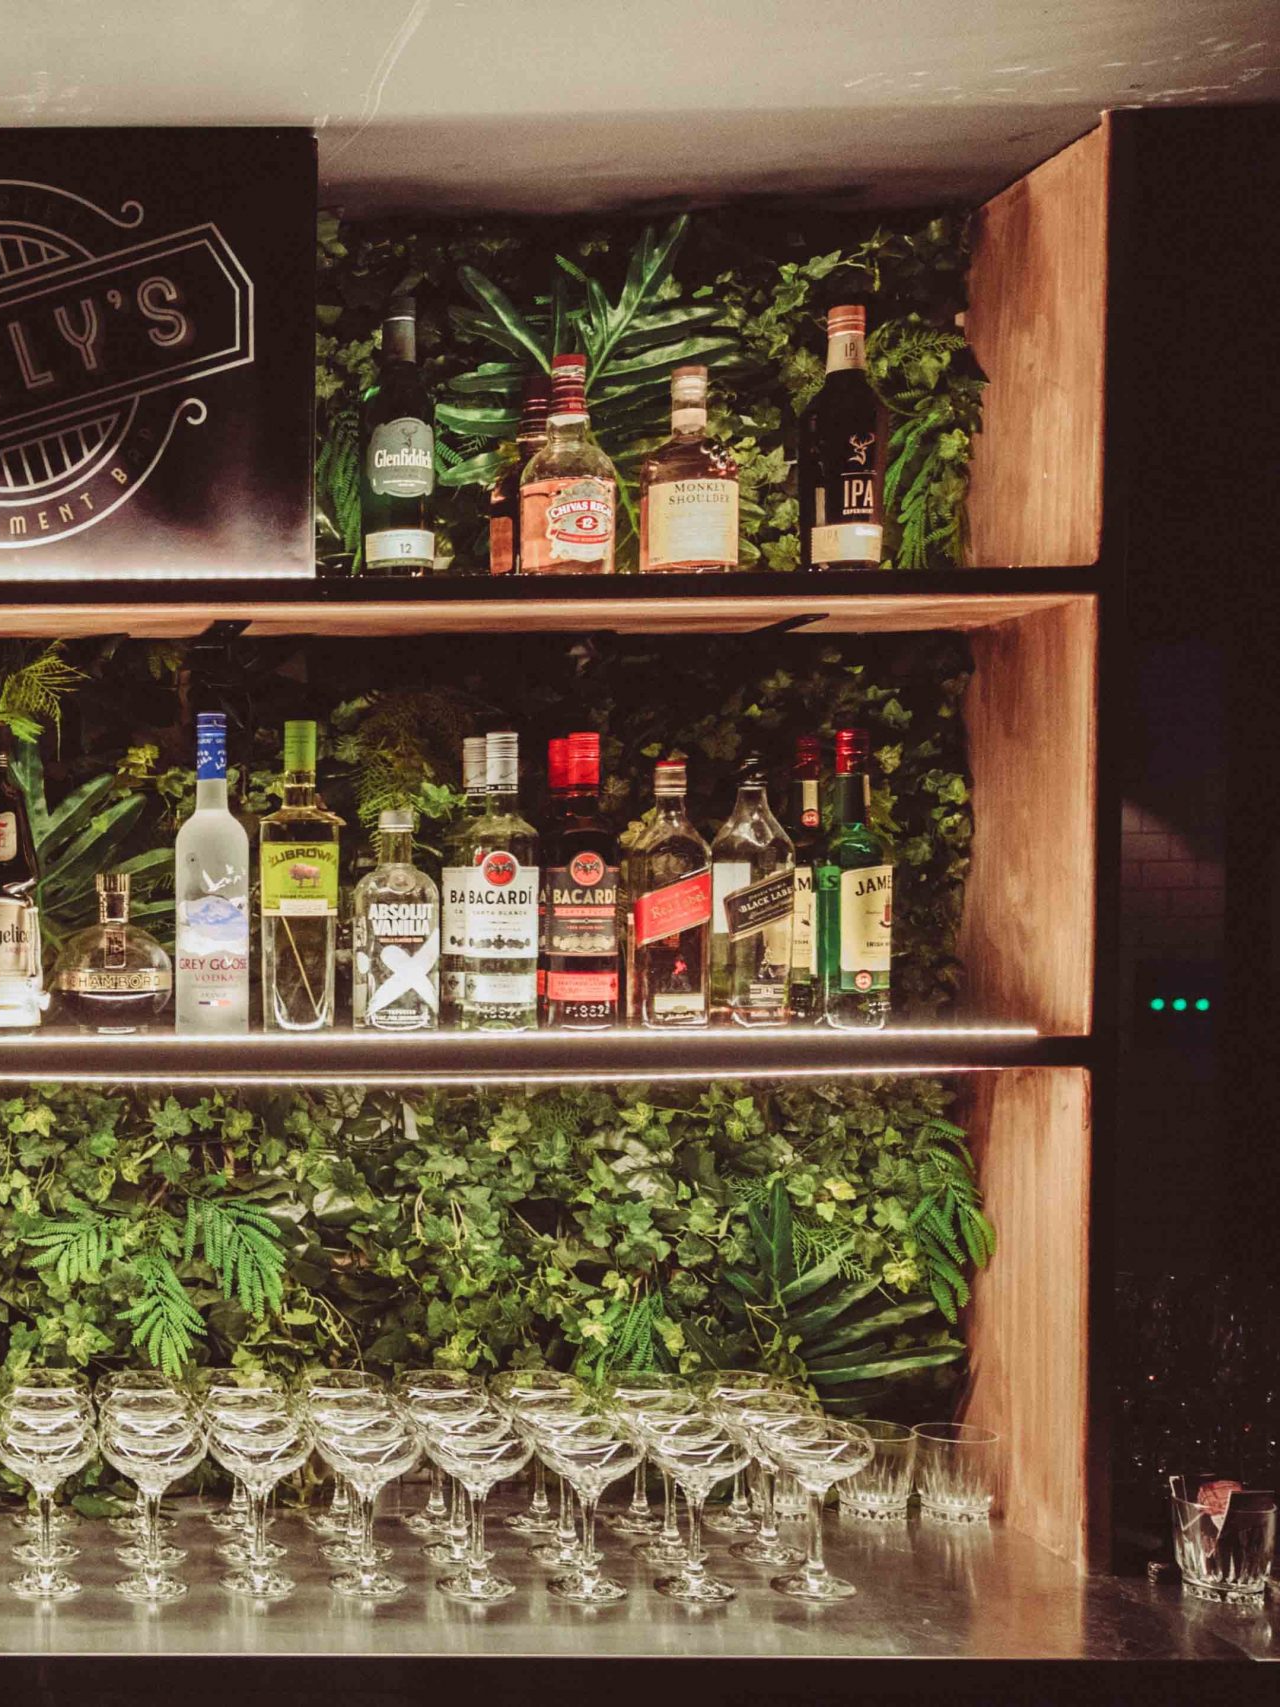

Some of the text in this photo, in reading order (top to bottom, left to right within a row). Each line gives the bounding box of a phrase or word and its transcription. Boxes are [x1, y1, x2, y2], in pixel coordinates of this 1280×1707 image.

[674, 482, 726, 493] MONKEY
[843, 479, 874, 508] IPA
[550, 501, 589, 518] CHIVAS
[399, 543, 412, 554] 12
[855, 874, 893, 897] JAME
[738, 895, 770, 913] BLACK
[770, 885, 794, 902] LABE
[368, 903, 434, 920] ABSOLUT
[179, 957, 248, 970] GREY GOOSE
